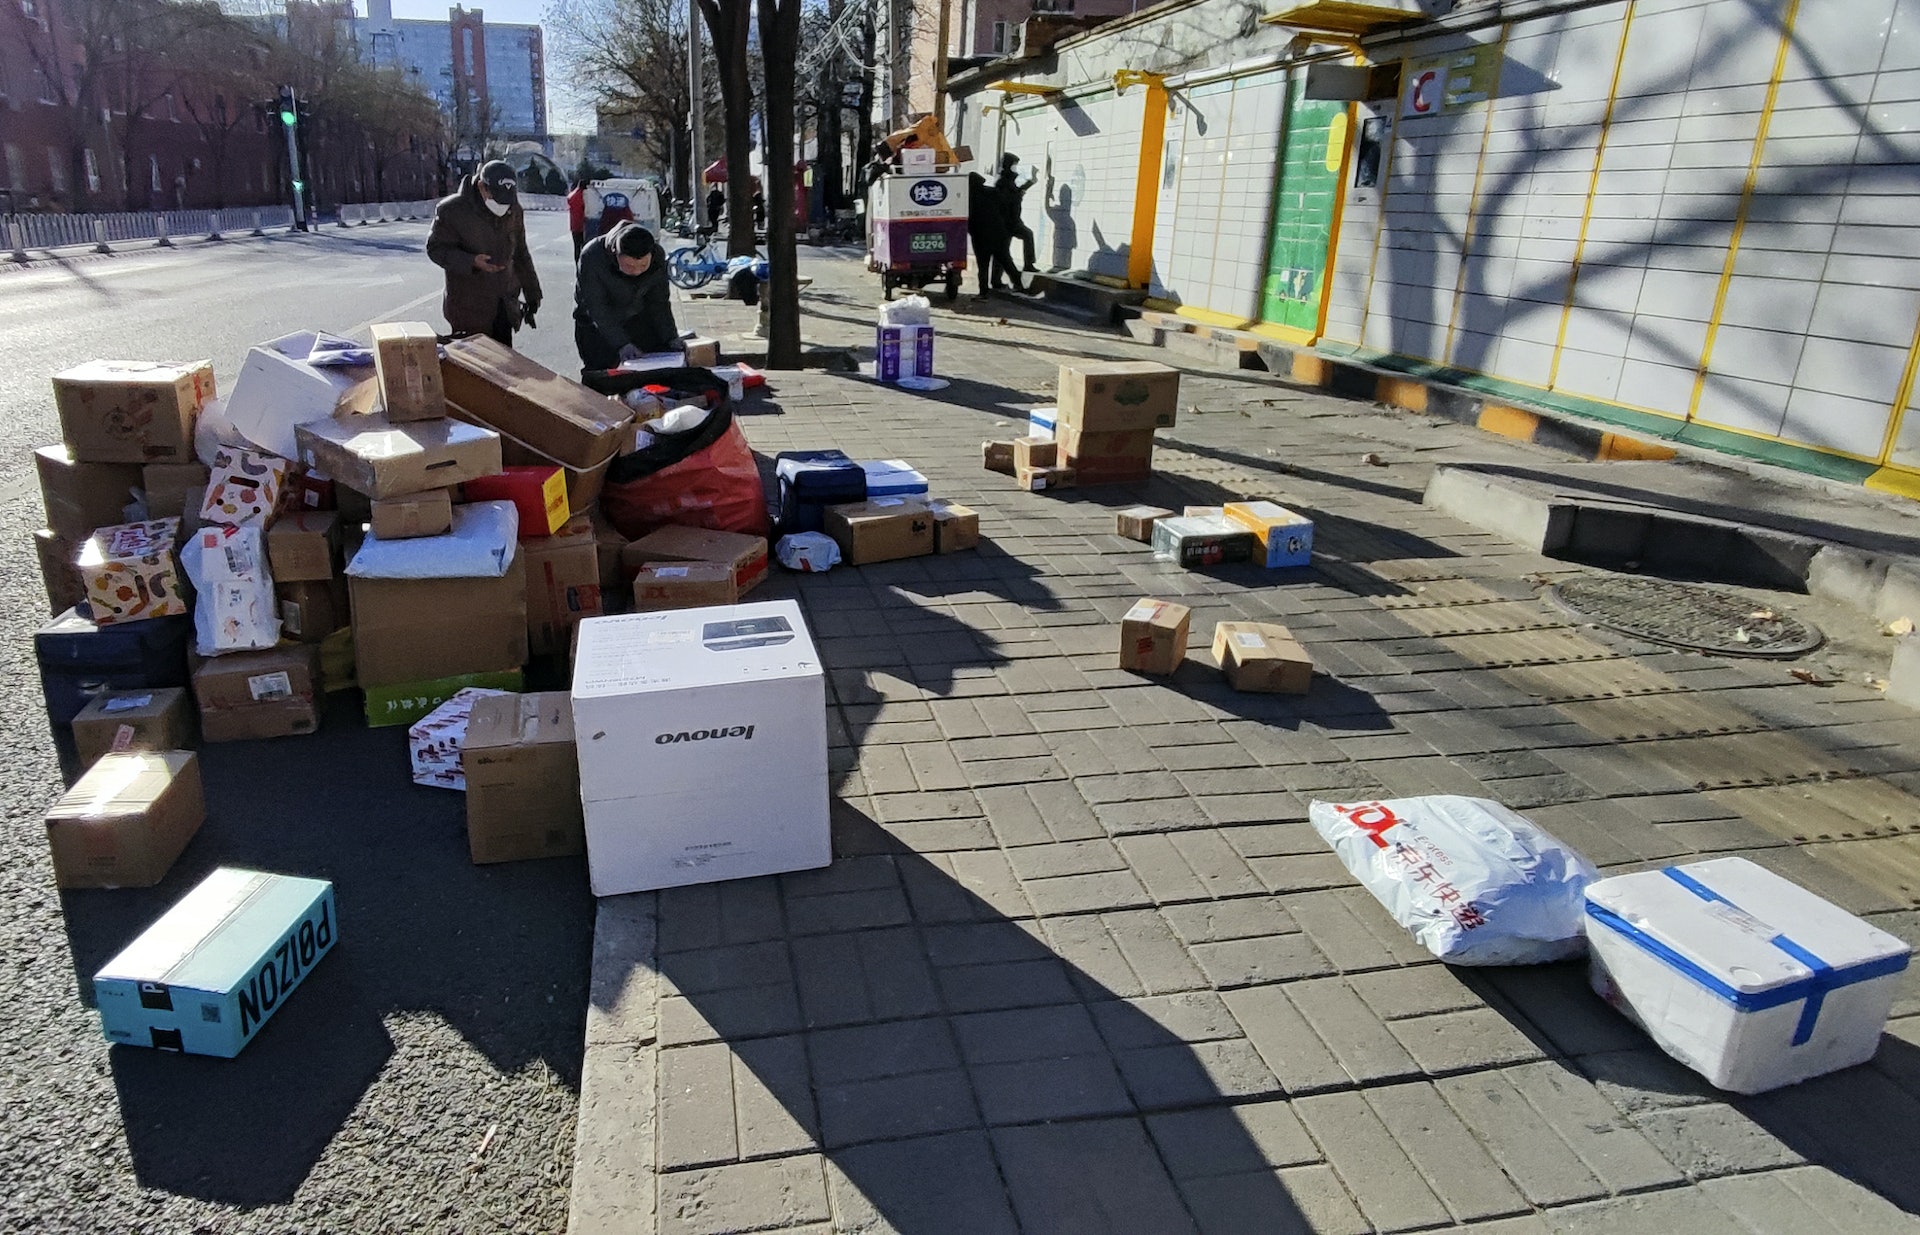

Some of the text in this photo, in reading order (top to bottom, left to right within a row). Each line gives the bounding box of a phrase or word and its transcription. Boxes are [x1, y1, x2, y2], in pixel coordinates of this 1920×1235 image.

[914, 185, 944, 201] 快递
[912, 241, 944, 250] 03296
[655, 725, 755, 745] lenovo
[1391, 842, 1486, 932] 京东快递
